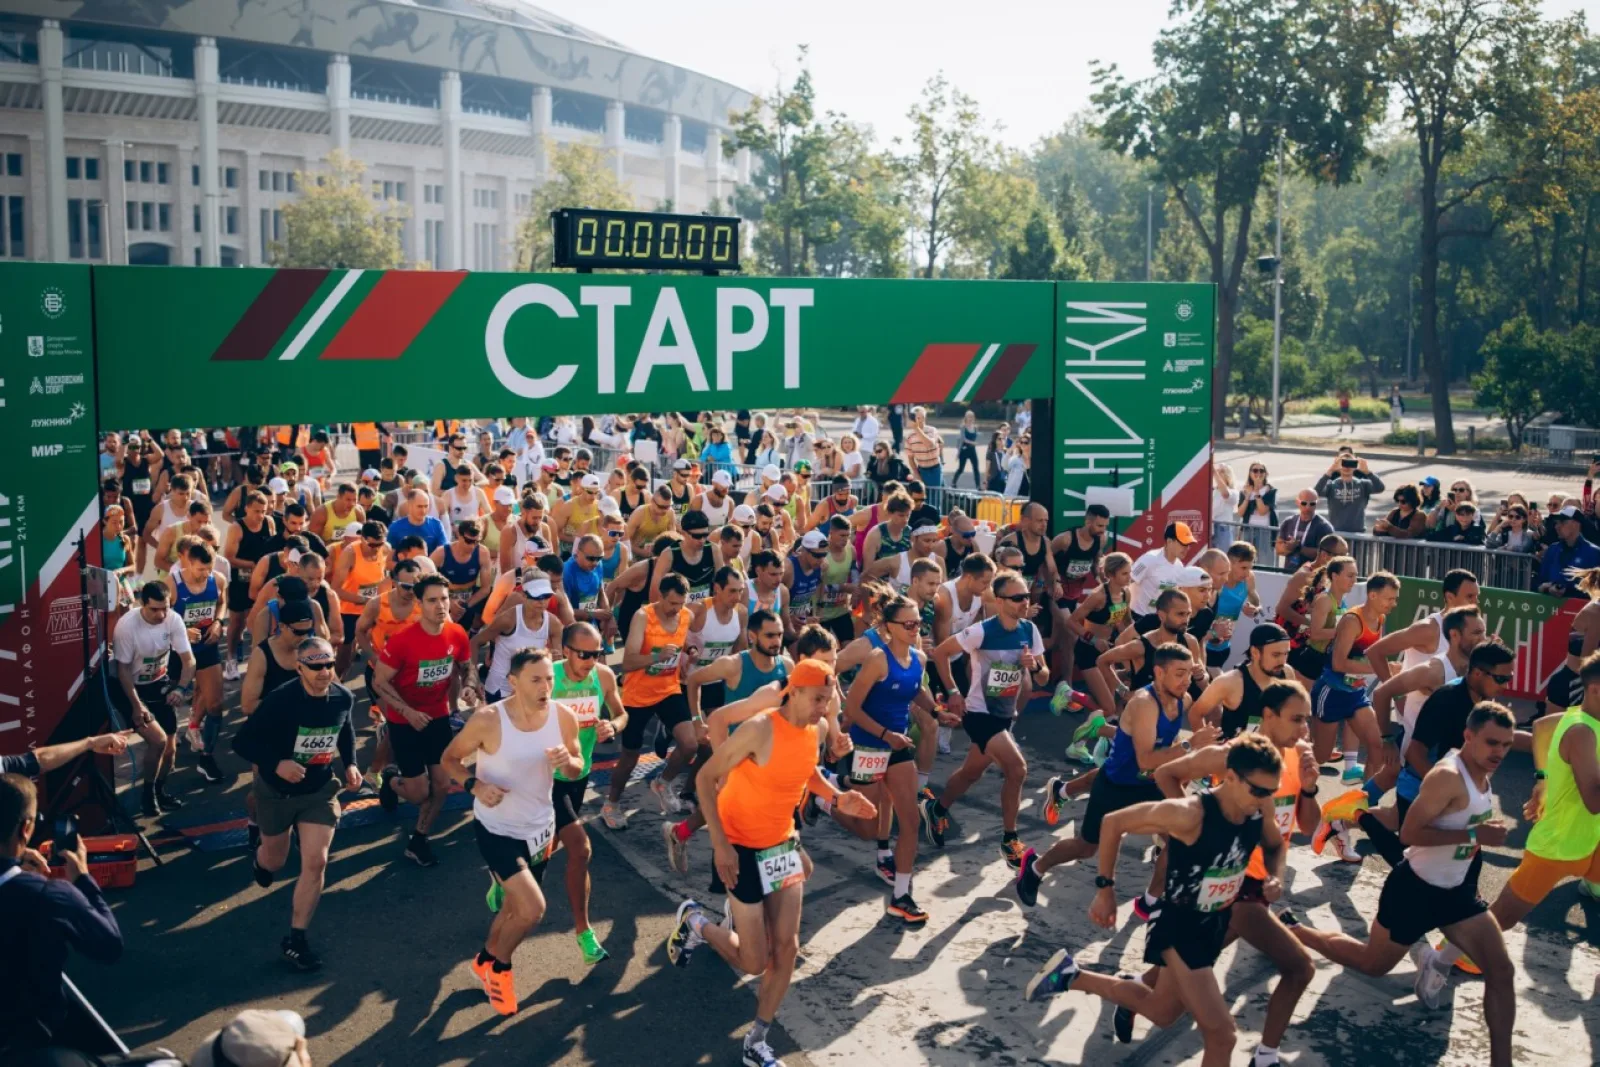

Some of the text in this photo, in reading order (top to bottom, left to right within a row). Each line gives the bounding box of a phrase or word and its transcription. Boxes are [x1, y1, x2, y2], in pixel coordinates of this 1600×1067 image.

[485, 282, 815, 399] СТАРТ
[1161, 405, 1186, 415] МИР
[31, 417, 72, 428] ЛУЖНИКИ
[31, 443, 64, 458] МИР
[188, 607, 212, 619] 5340
[422, 664, 449, 679] 5655
[993, 670, 1020, 683] 3060
[300, 736, 334, 749] 4662
[858, 755, 887, 769] 7899
[764, 855, 796, 877] 5474
